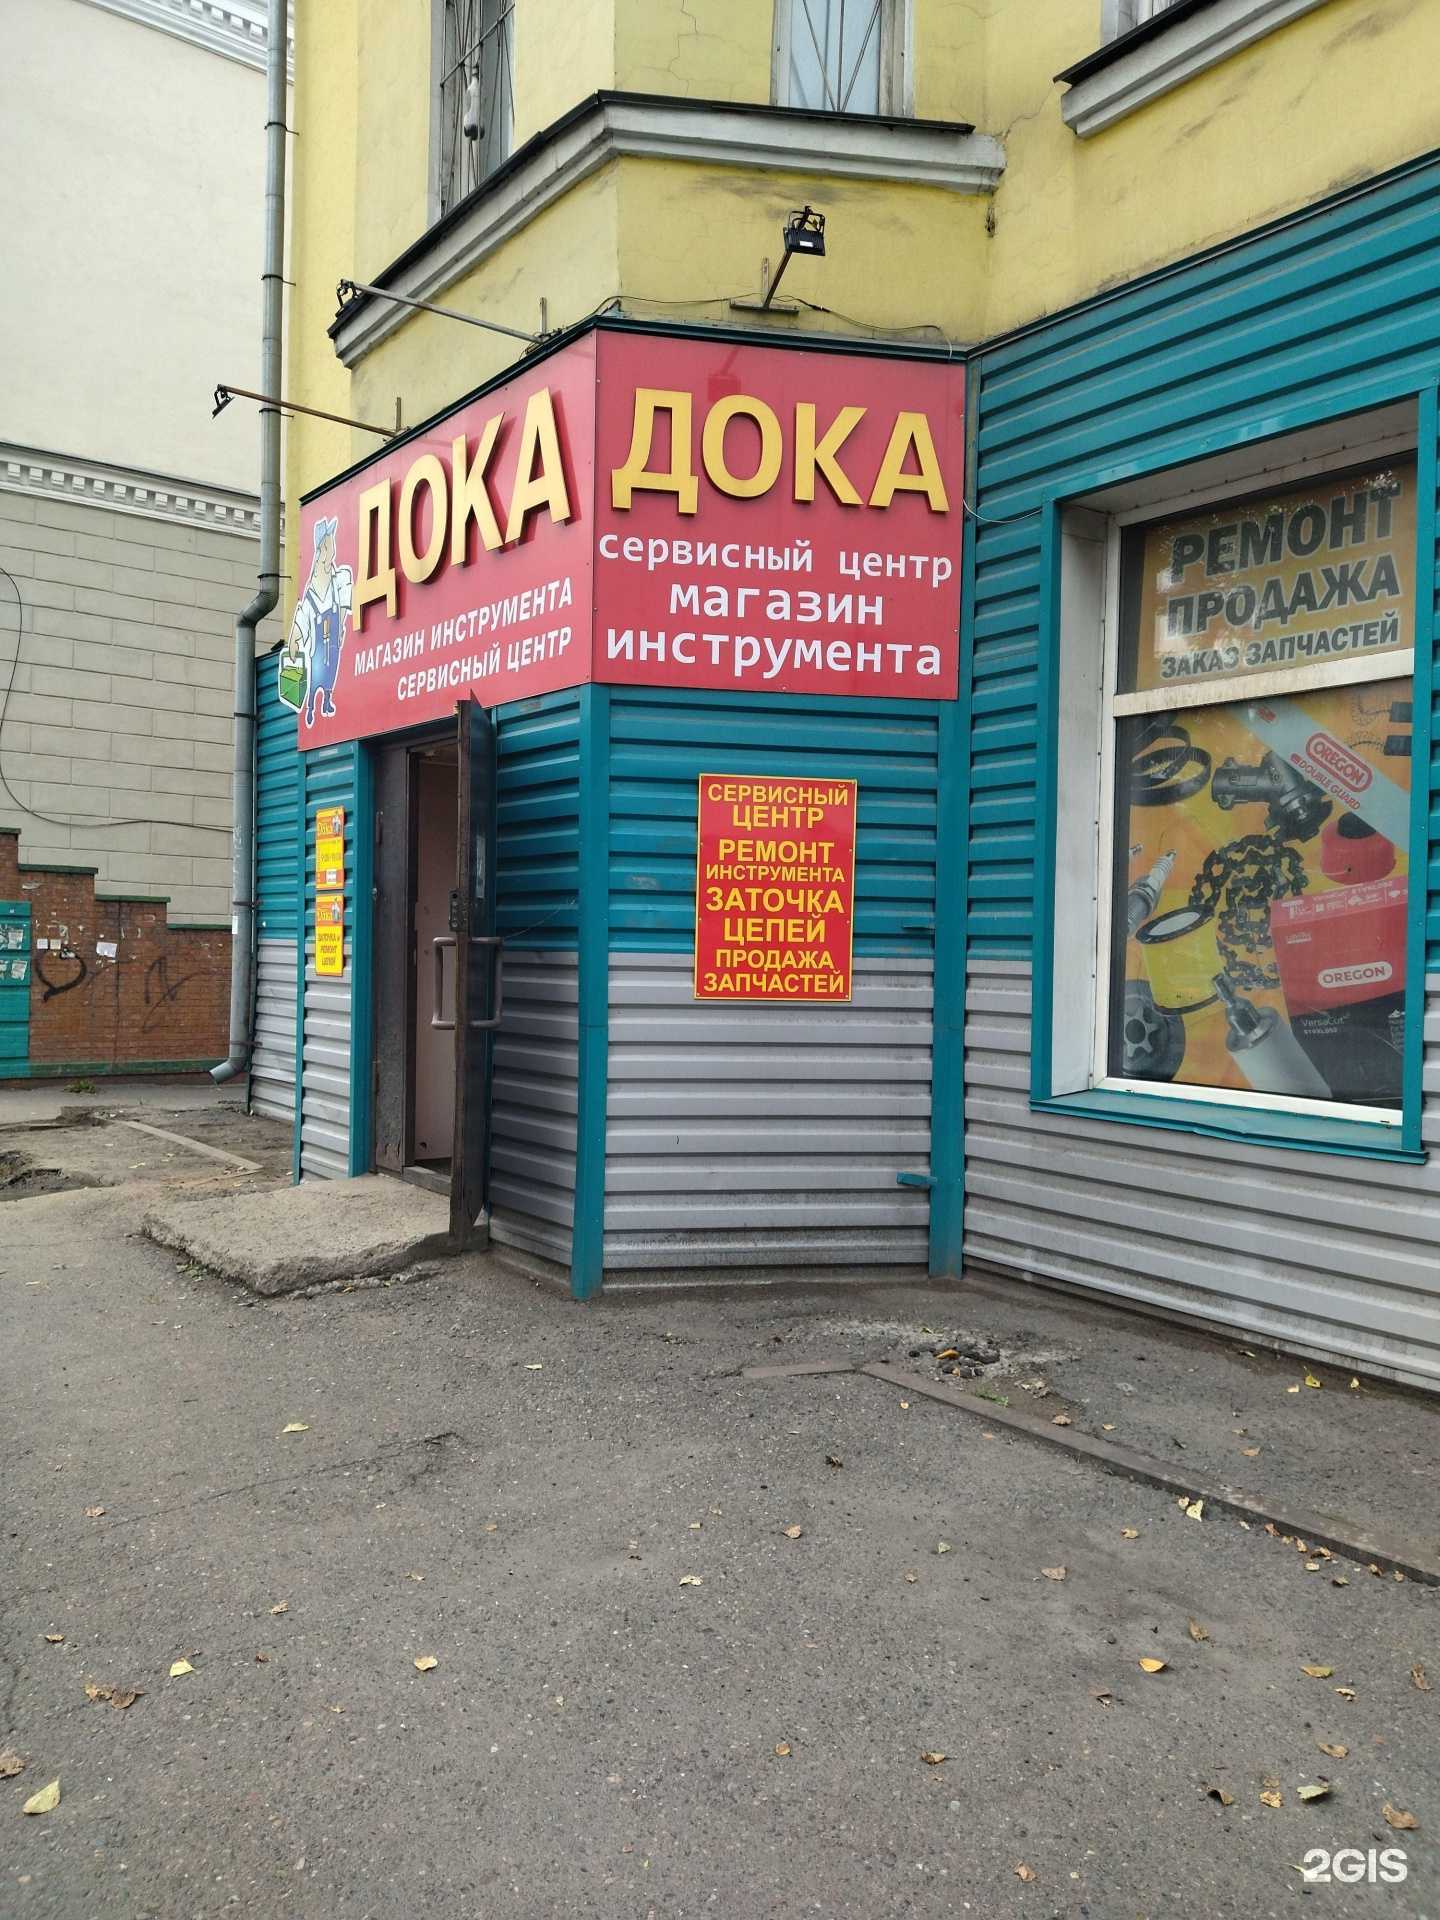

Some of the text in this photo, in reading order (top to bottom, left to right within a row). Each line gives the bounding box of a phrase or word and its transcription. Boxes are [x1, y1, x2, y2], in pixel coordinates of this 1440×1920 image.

[611, 387, 950, 514] ДОКА
[352, 386, 570, 632] ДОКА
[1170, 484, 1401, 585] РЕМОНТ
[599, 534, 953, 588] сервисный центр
[669, 583, 883, 626] магазин
[1166, 554, 1401, 637] ПРОДАЖА
[354, 577, 573, 677] МАГАЗИН ИНСТРУМЕНТА
[1161, 610, 1399, 679] ЗАКАЗ ЗАПЧАСТЕЙ
[397, 626, 573, 701] СЕРВИСНЫЙ ЦЕНТР
[607, 628, 942, 679] инструмента
[1313, 740, 1365, 786] OREGON
[707, 783, 848, 806] СЕРВИСНЫЙ
[732, 804, 824, 831] ЦЕНТР
[705, 864, 846, 883] ИНСТРУМЕНТА
[718, 839, 835, 864] РЕМОНТ
[705, 886, 845, 914] ЗАТОЧКА
[724, 913, 826, 946] ЦЕПЕЙ
[703, 969, 845, 993] ЗАПЧАСТЕЙ
[715, 949, 835, 972] ПРОДАЖА
[1322, 965, 1386, 984] OREGON
